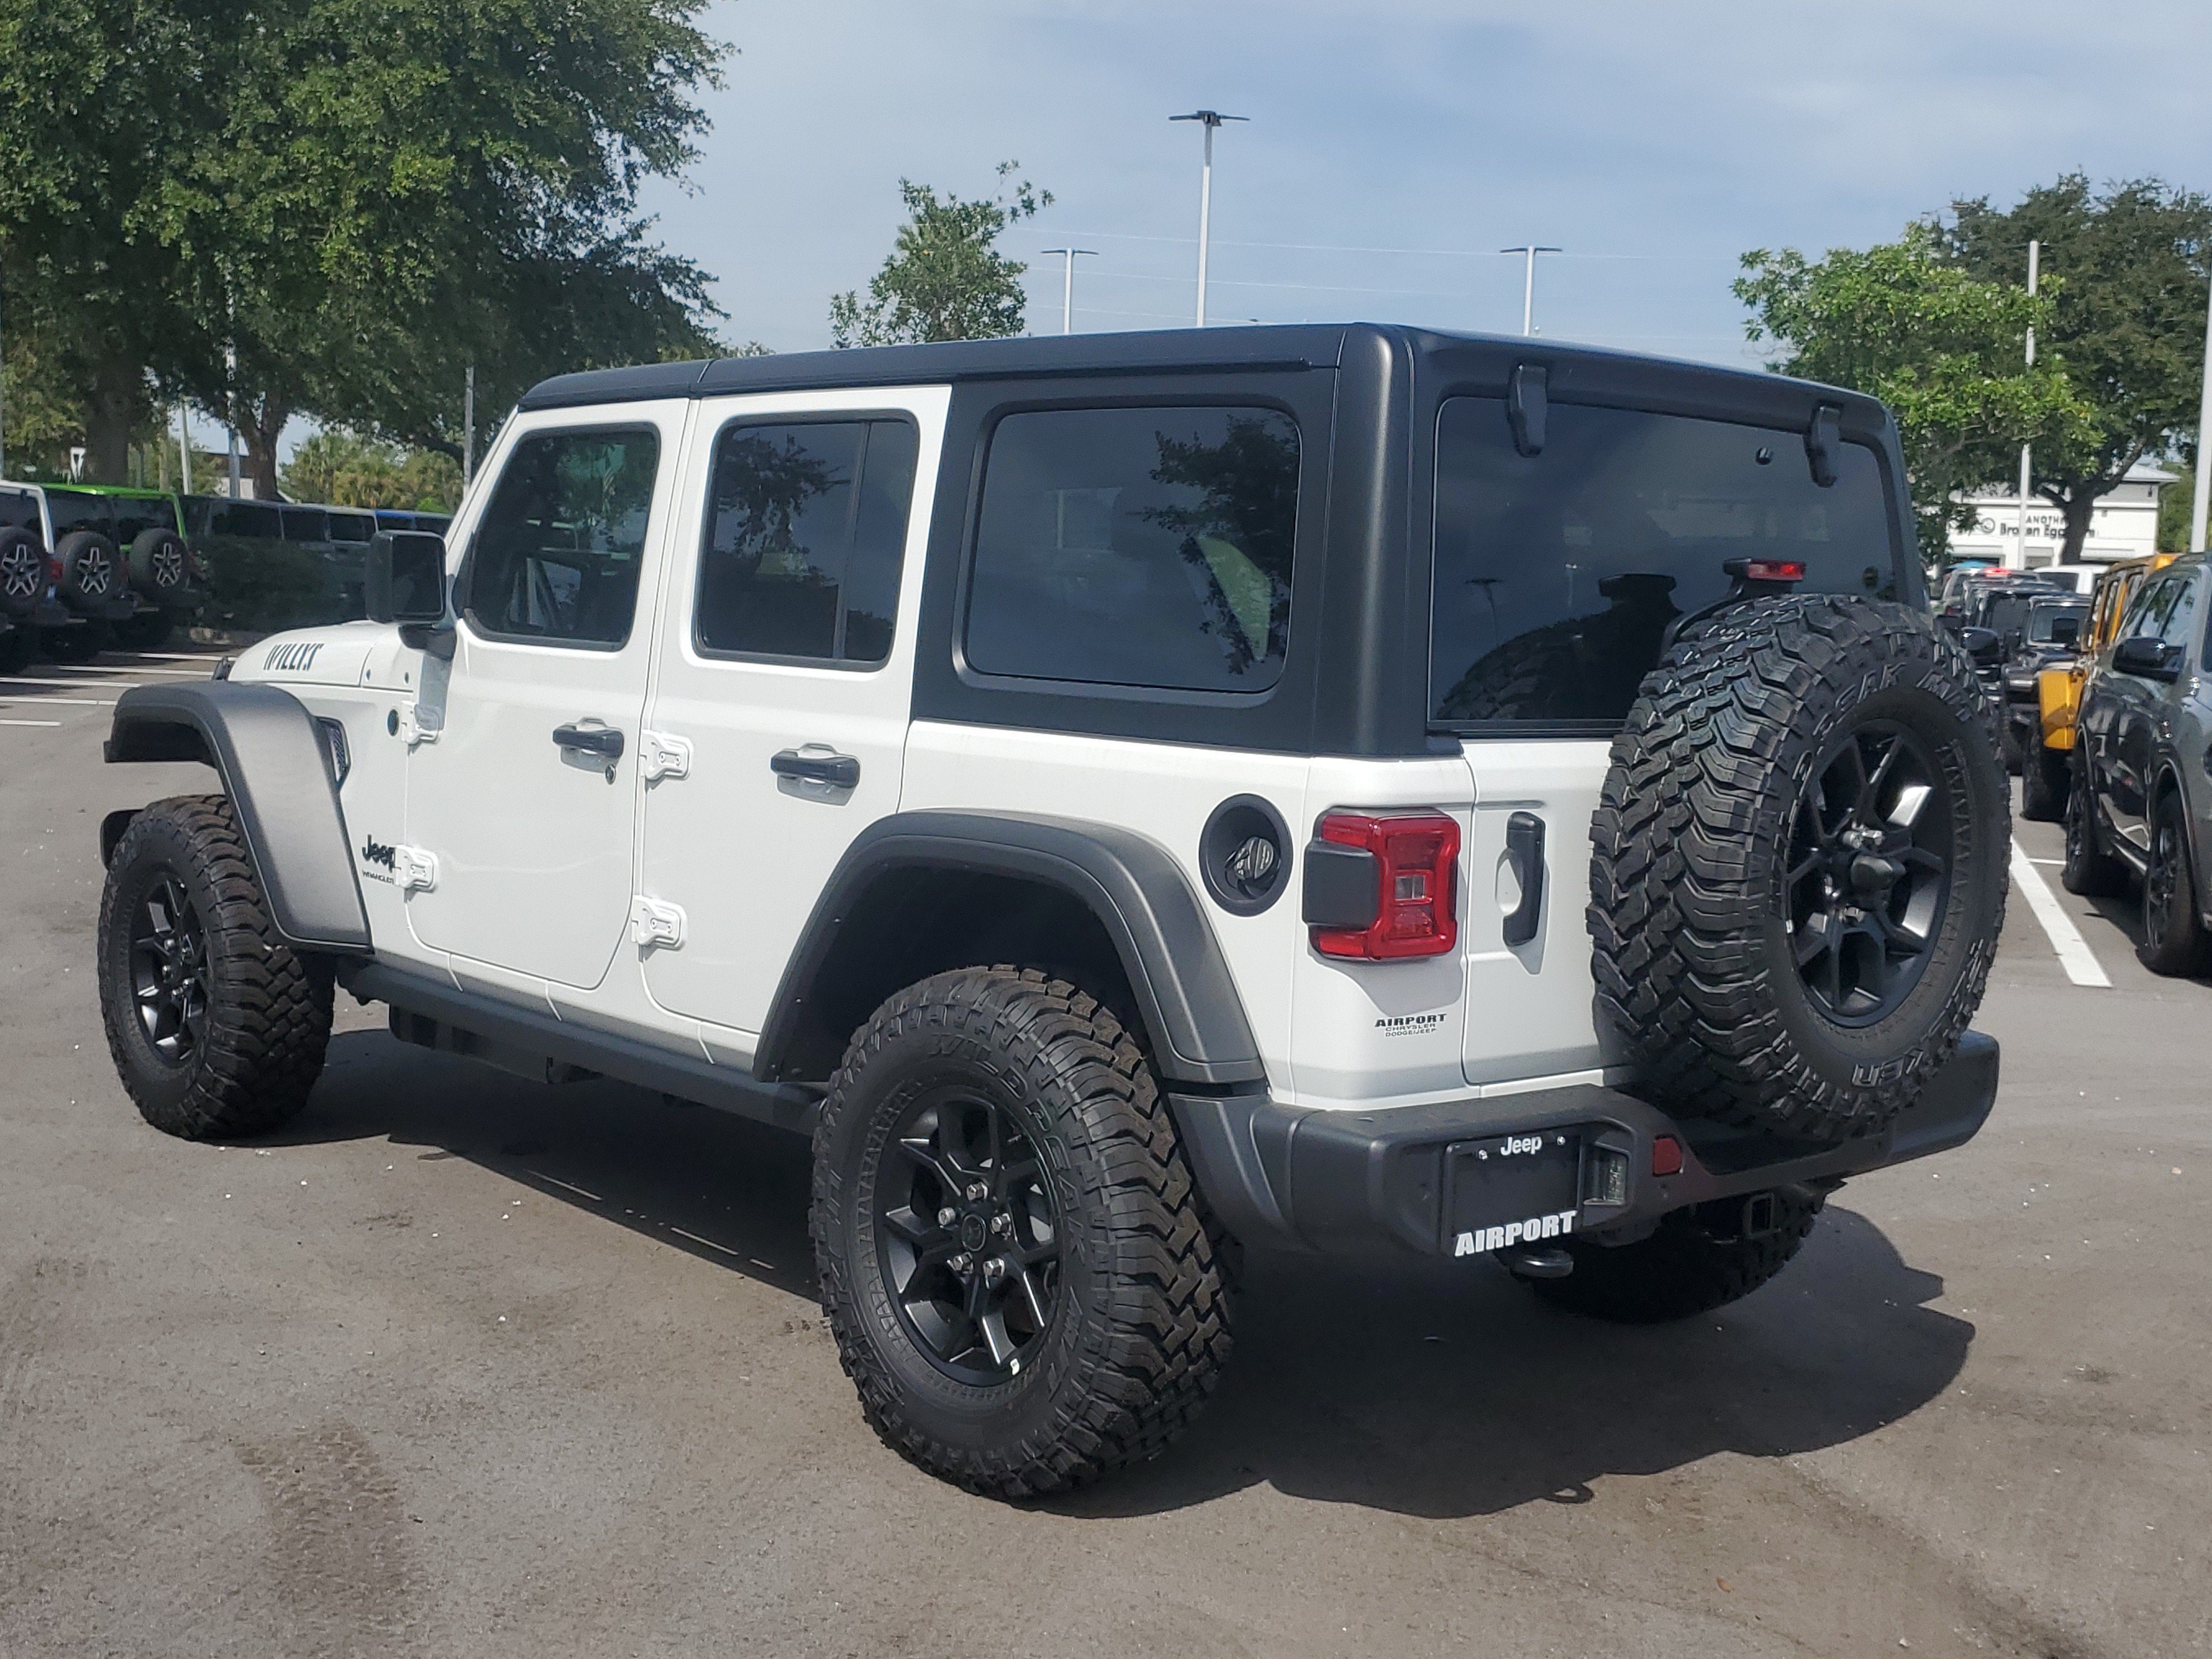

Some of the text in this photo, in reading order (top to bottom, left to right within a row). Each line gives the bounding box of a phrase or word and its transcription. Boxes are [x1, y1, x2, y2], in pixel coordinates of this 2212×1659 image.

[2000, 522, 2040, 536] Broen
[263, 643, 325, 672] WILLYS
[362, 833, 396, 873] Jeep
[1374, 1013, 1447, 1028] AIRPORT
[1385, 1023, 1436, 1032] CHRYSLER
[1500, 1136, 1543, 1156] Jeep
[1454, 1209, 1579, 1257] AIRPORT
